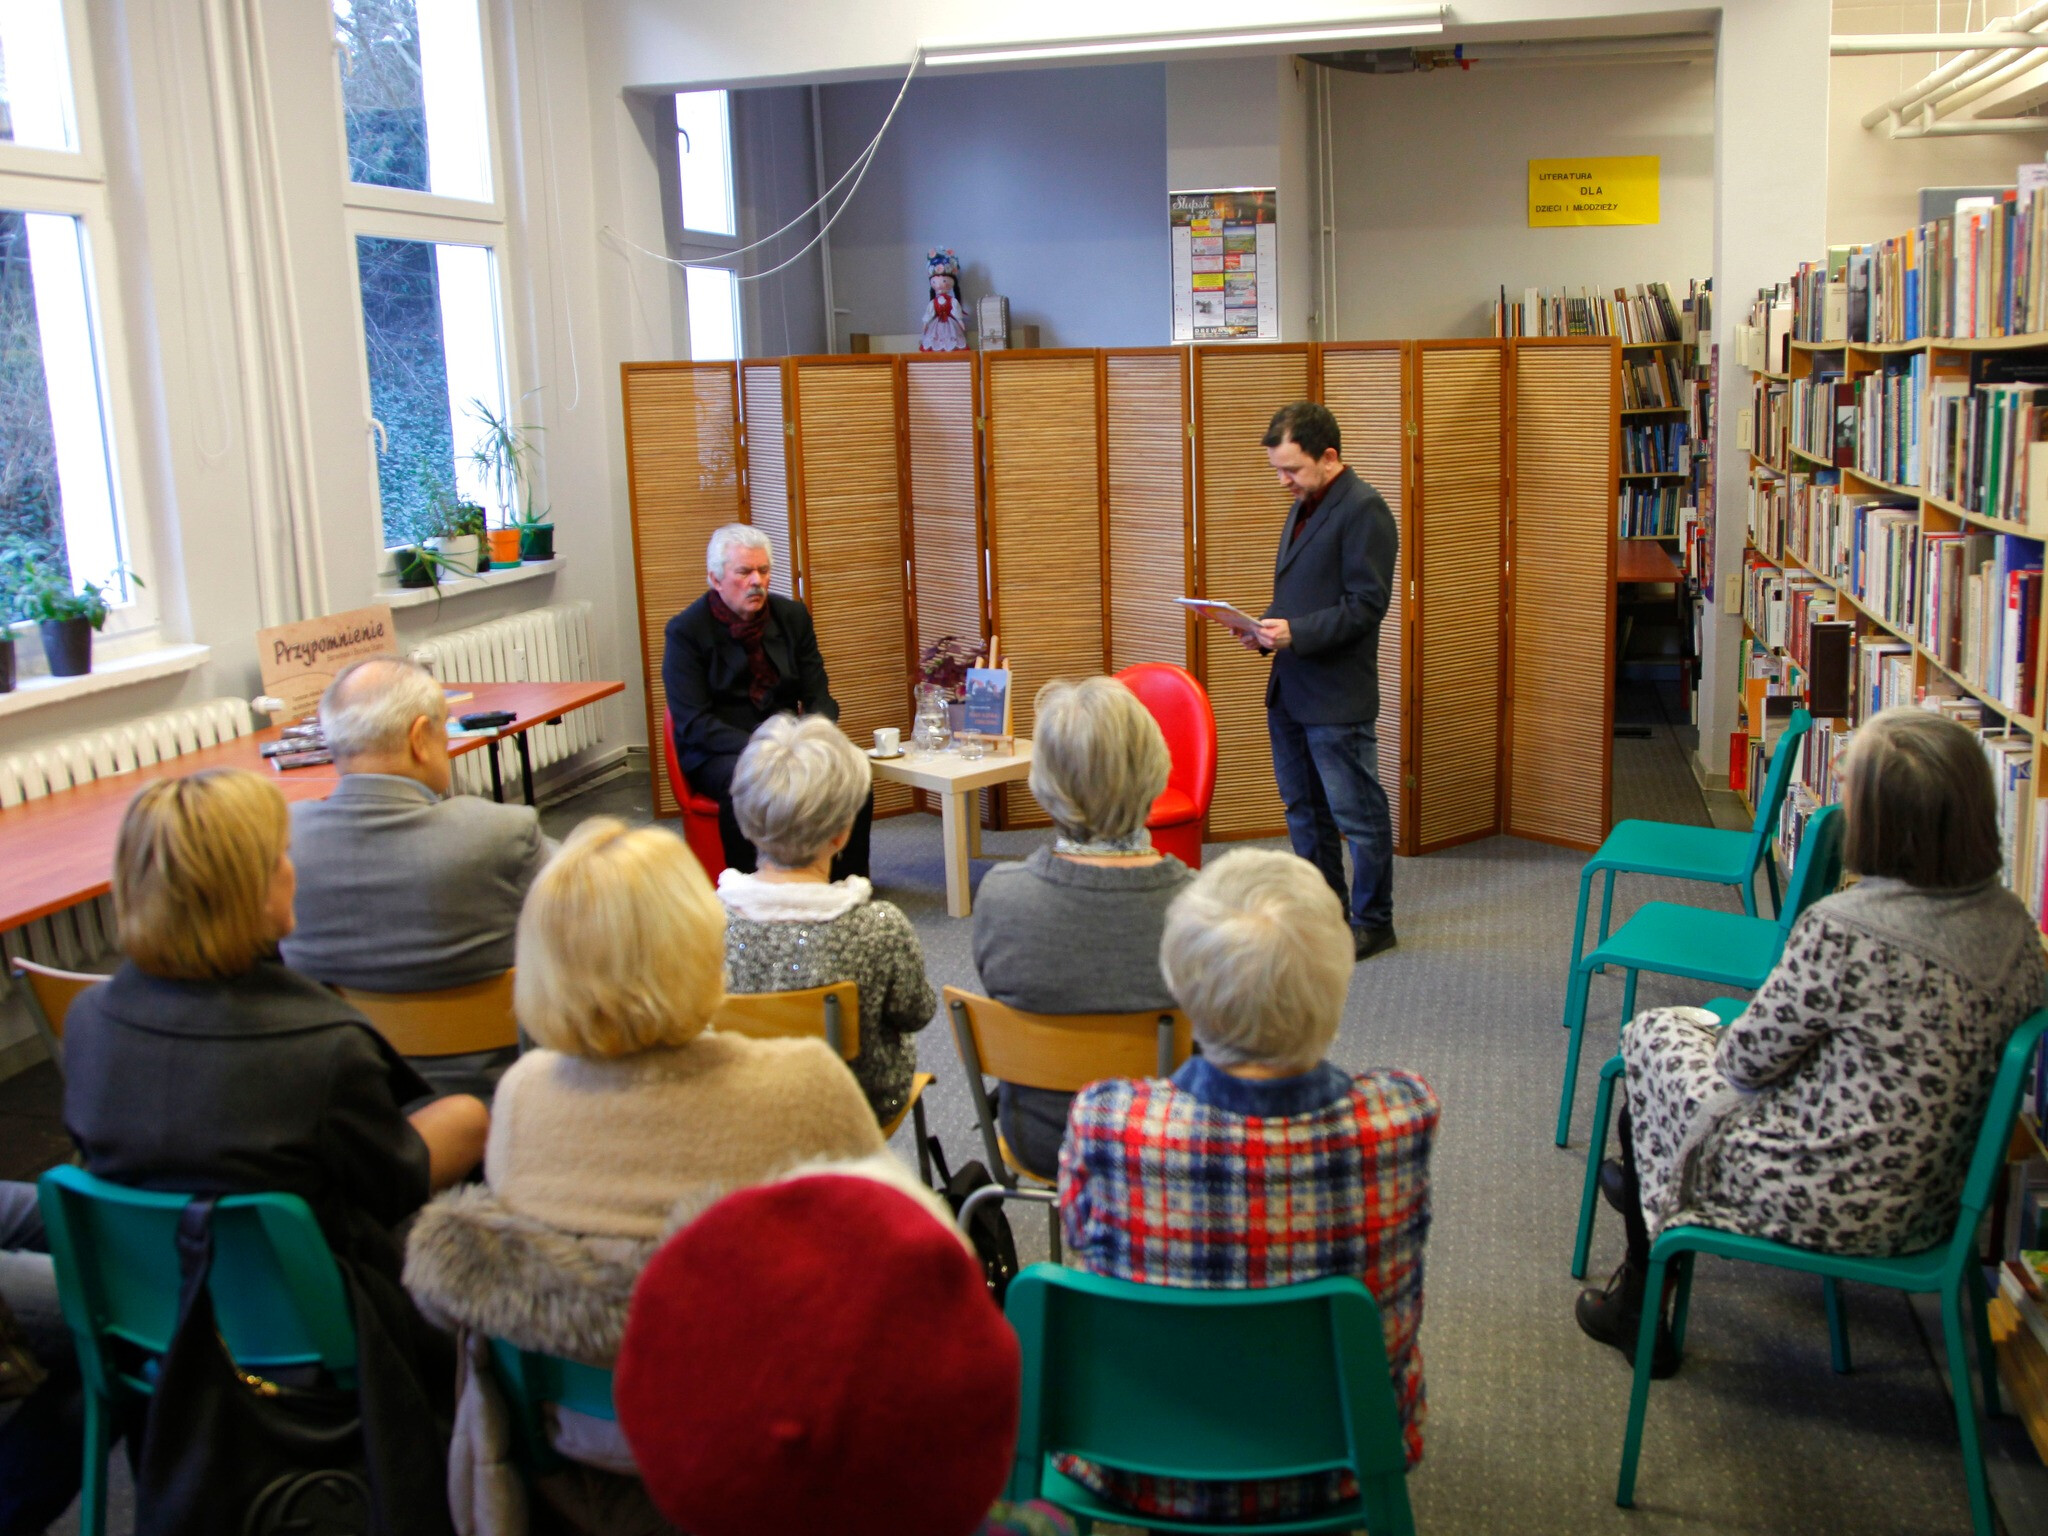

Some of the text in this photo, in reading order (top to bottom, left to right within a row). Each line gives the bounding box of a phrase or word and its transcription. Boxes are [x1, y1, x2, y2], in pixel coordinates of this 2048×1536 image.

[1539, 173, 1593, 181] LITERATURA
[1580, 186, 1603, 195] DLA
[1536, 204, 1562, 213] DZIECI
[1573, 203, 1618, 211] MŁODZIEŻY
[273, 620, 385, 667] Przypomnienie
